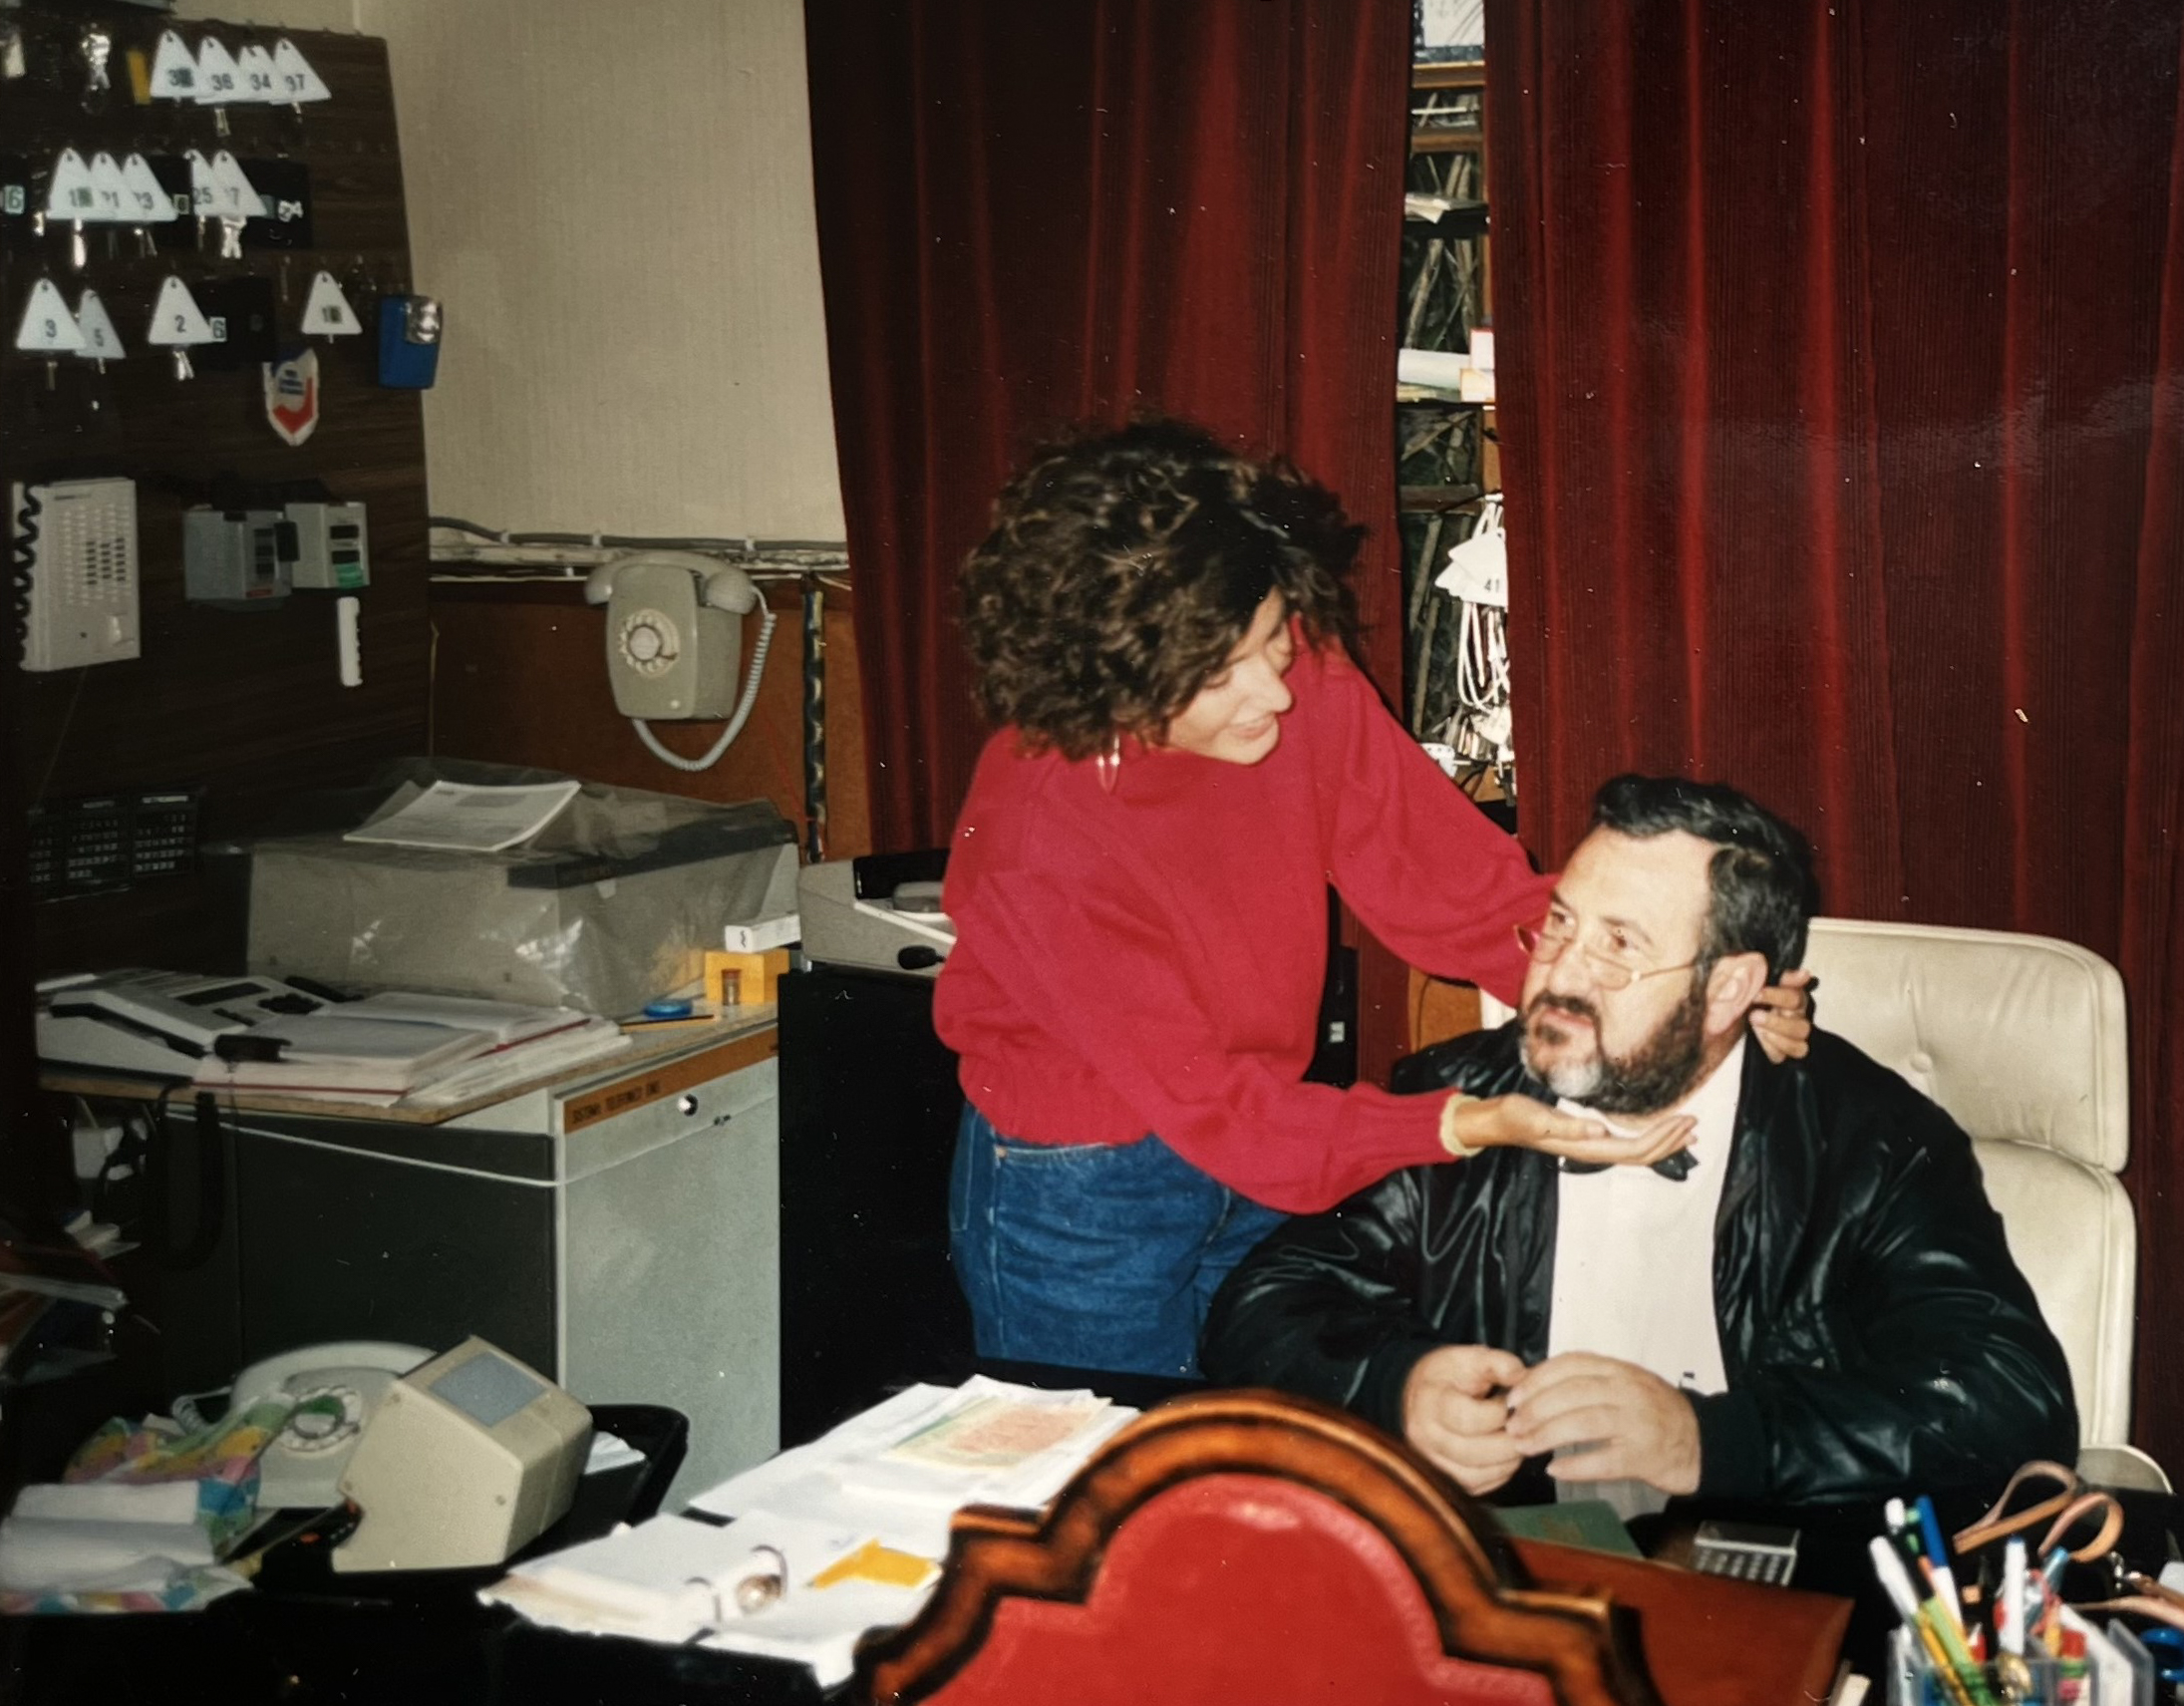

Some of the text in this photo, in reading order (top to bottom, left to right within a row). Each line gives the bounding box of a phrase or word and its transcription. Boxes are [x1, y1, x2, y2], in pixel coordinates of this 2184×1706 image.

[251, 73, 271, 91] 34
[45, 319, 57, 338] 3
[174, 314, 186, 333] 2
[1483, 578, 1500, 593] 41
